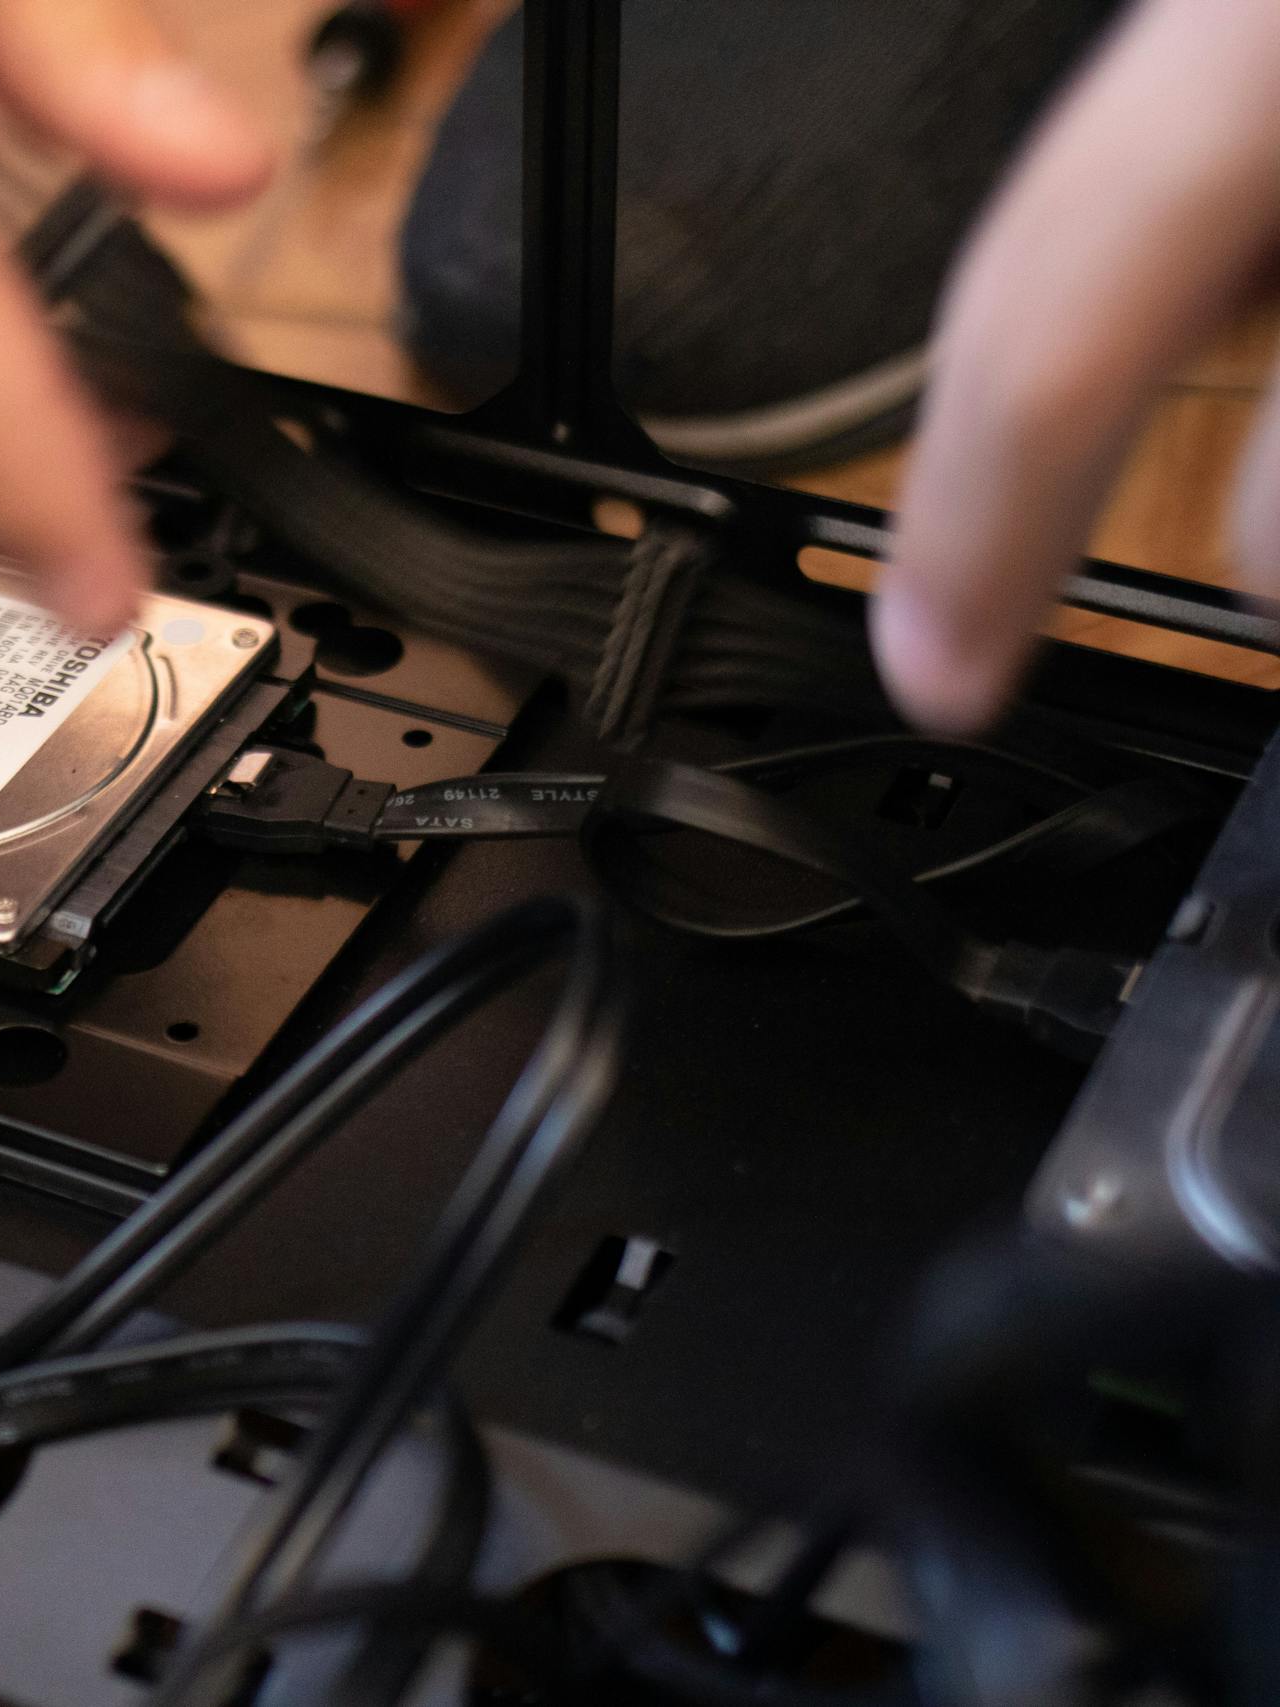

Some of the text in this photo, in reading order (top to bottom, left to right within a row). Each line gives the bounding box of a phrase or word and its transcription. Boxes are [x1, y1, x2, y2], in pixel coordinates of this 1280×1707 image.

[17, 632, 113, 721] TOSHIBA
[443, 787, 500, 801] 21149
[531, 788, 599, 802] STYLE
[415, 815, 474, 829] SATA
